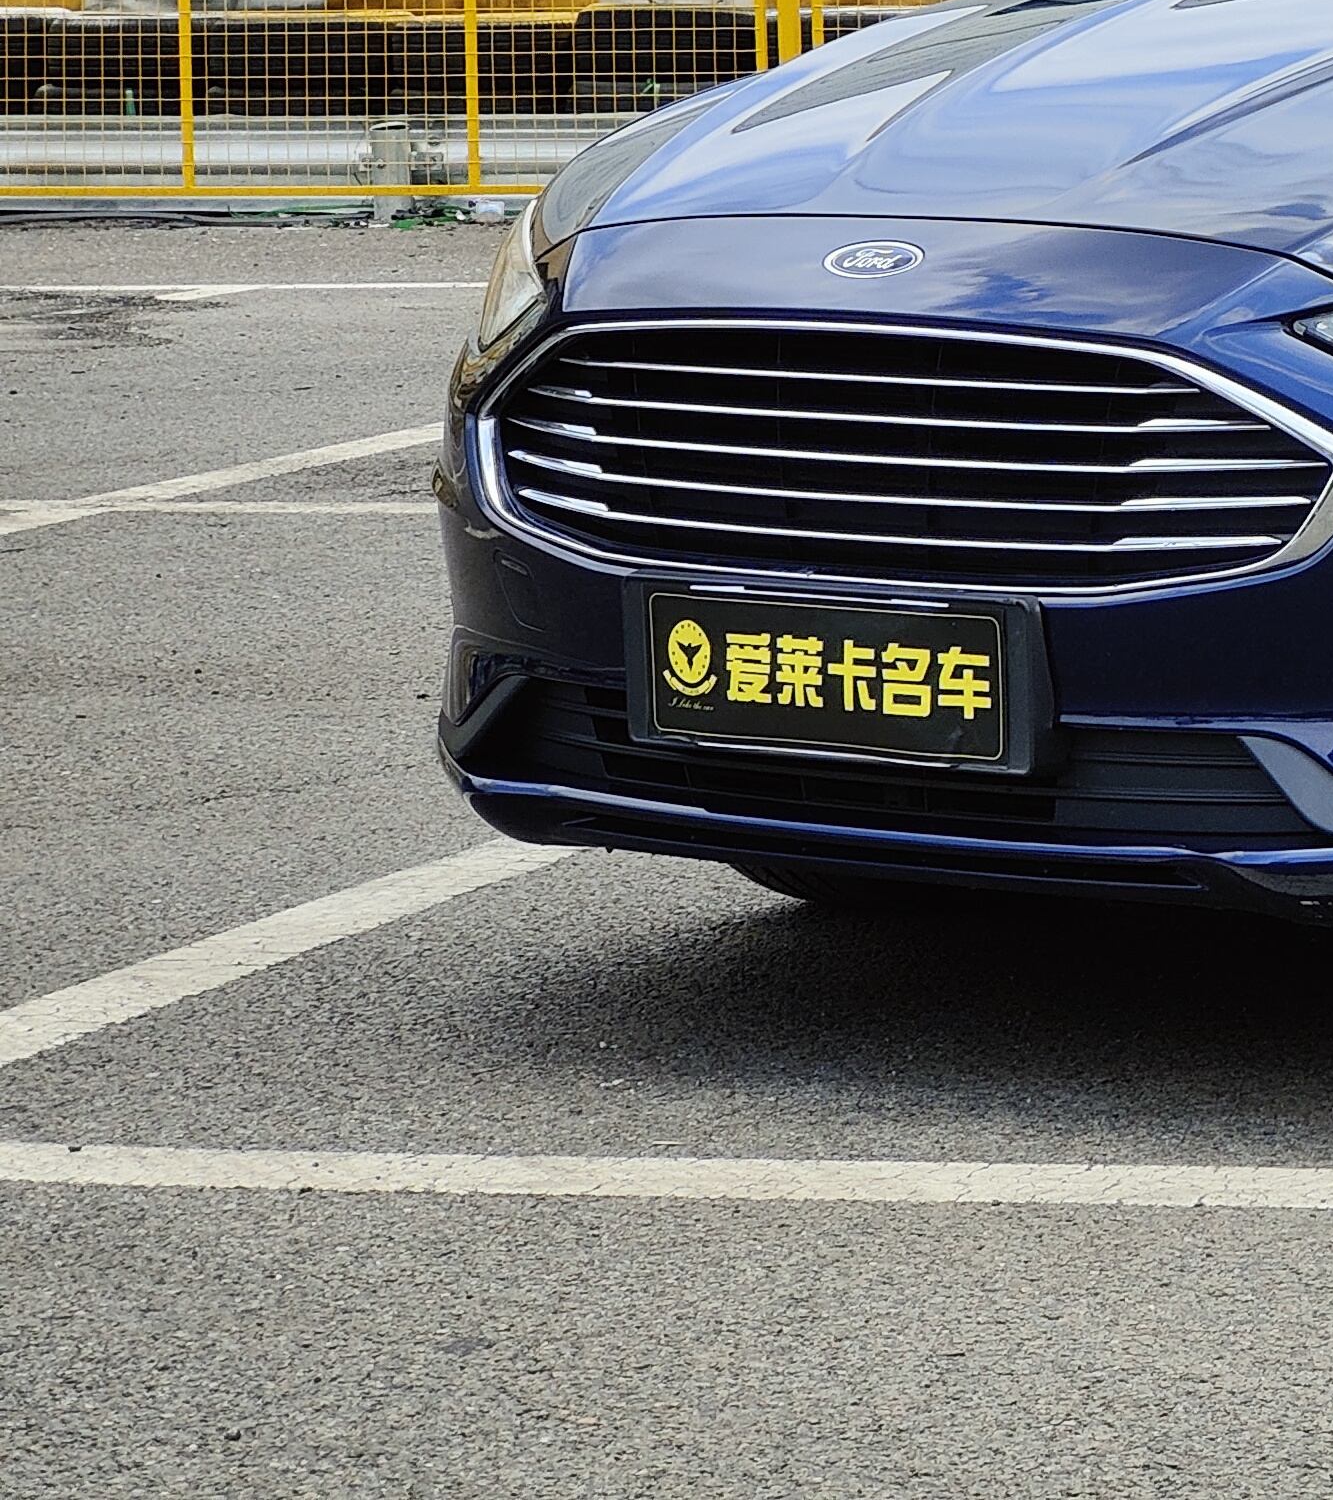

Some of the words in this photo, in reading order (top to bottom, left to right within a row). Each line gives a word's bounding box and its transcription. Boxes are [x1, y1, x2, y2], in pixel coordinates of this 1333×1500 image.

[842, 248, 902, 270] Ford
[725, 633, 991, 719] 爱莱卡名车
